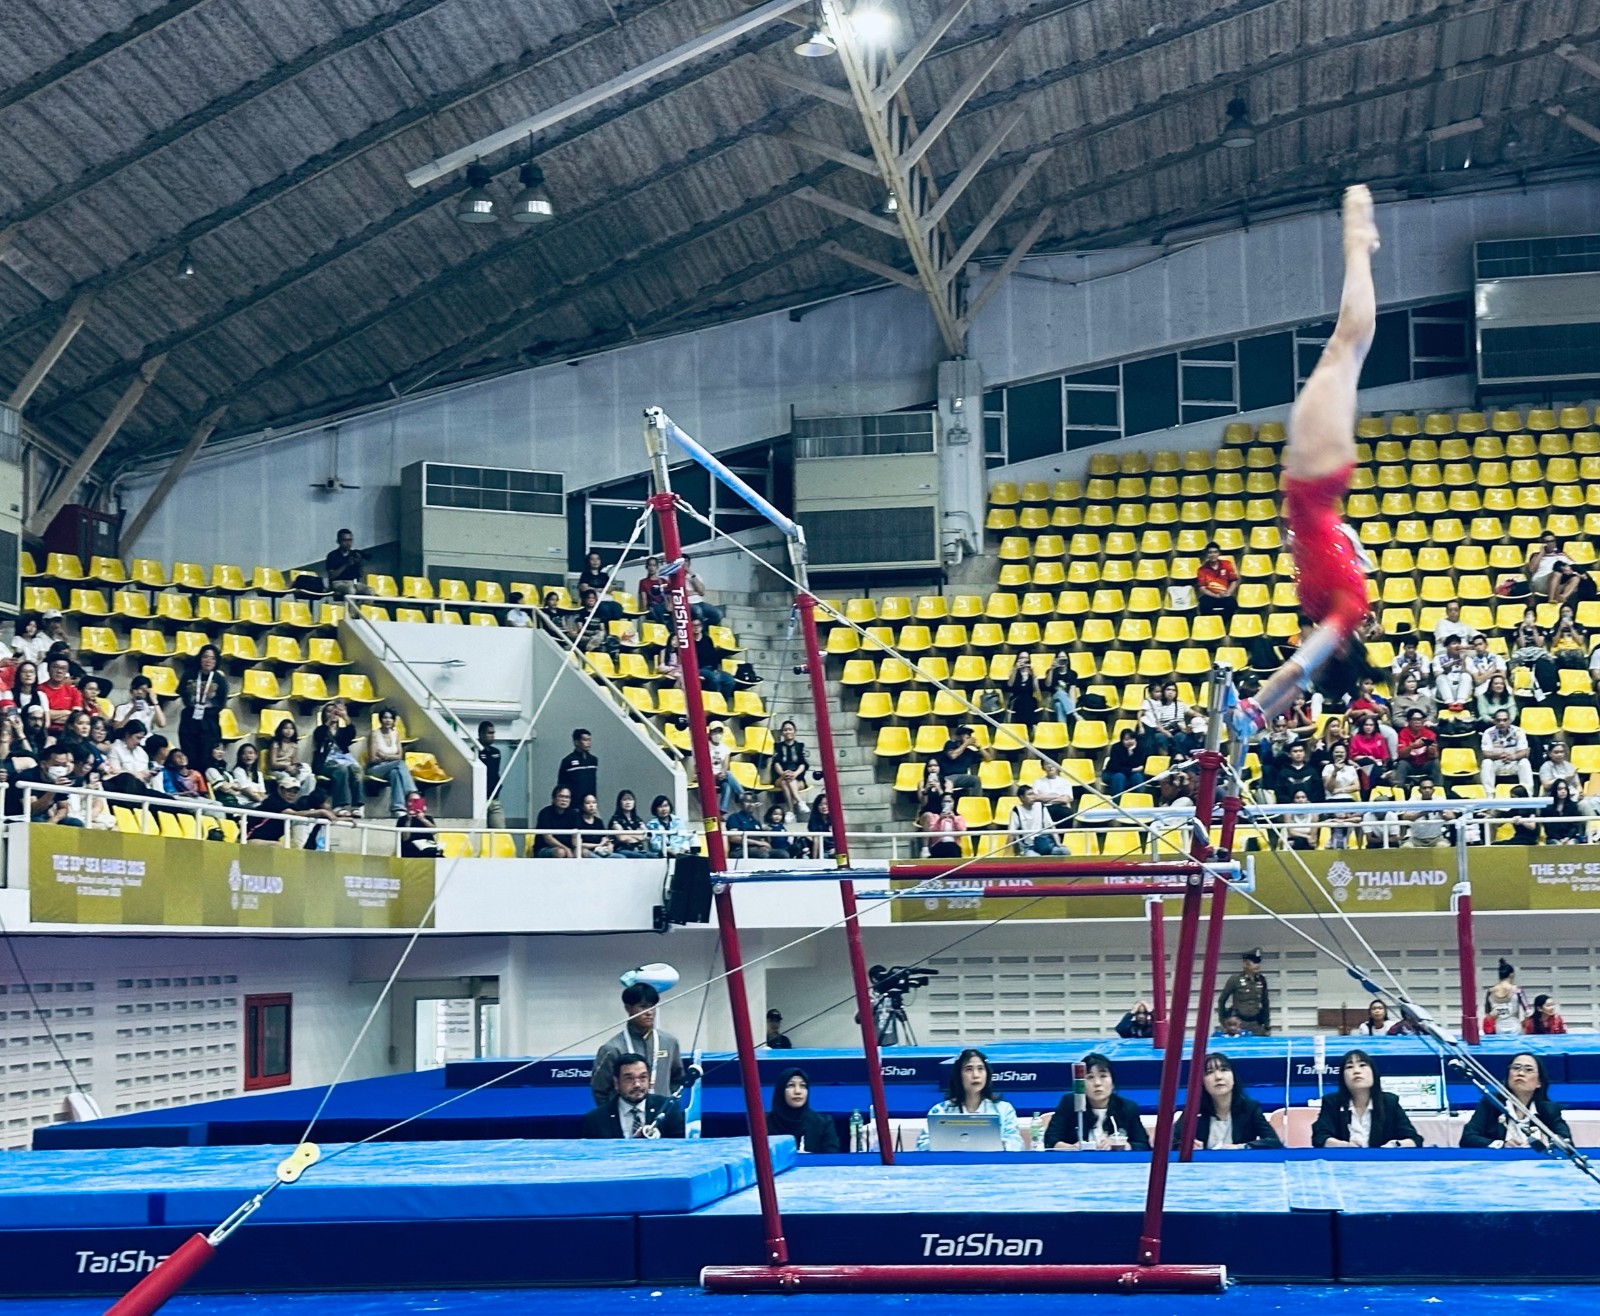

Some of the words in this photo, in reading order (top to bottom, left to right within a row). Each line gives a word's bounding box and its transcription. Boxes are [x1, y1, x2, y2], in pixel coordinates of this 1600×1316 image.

[671, 586, 689, 649] TaiShan
[857, 787, 865, 795] C
[1528, 863, 1555, 876] THE
[1584, 862, 1600, 875] SE
[1354, 870, 1448, 887] THAILAND
[1356, 887, 1393, 901] 2025
[880, 1065, 916, 1076] iShan
[991, 1070, 1037, 1081] aiShan
[920, 1232, 1044, 1257] TaiShan
